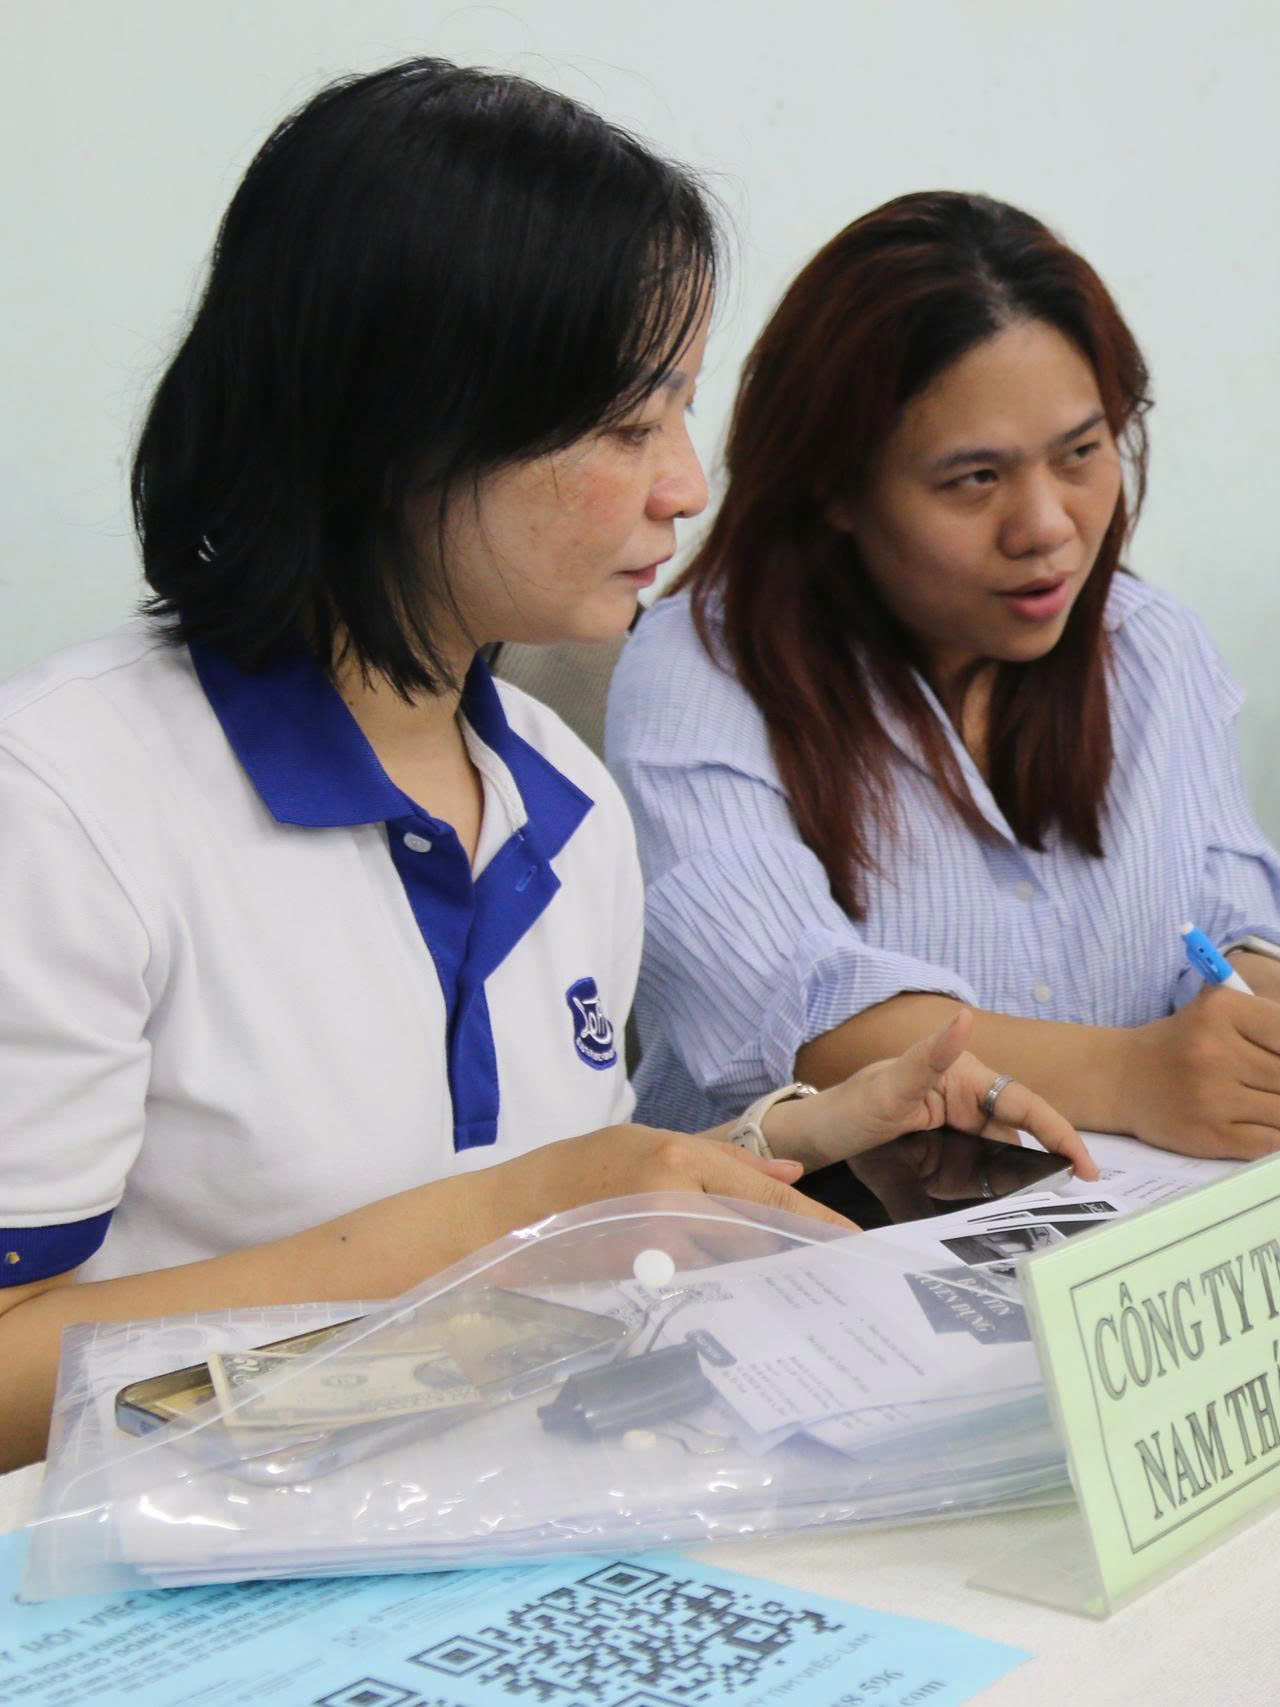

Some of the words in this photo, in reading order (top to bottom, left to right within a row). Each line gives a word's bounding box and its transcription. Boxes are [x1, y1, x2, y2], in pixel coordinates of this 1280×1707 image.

[1095, 1281, 1206, 1401] CÔNG
[1201, 1254, 1254, 1346] TY
[1135, 1403, 1233, 1520] NAM
[859, 1668, 904, 1694] 596
